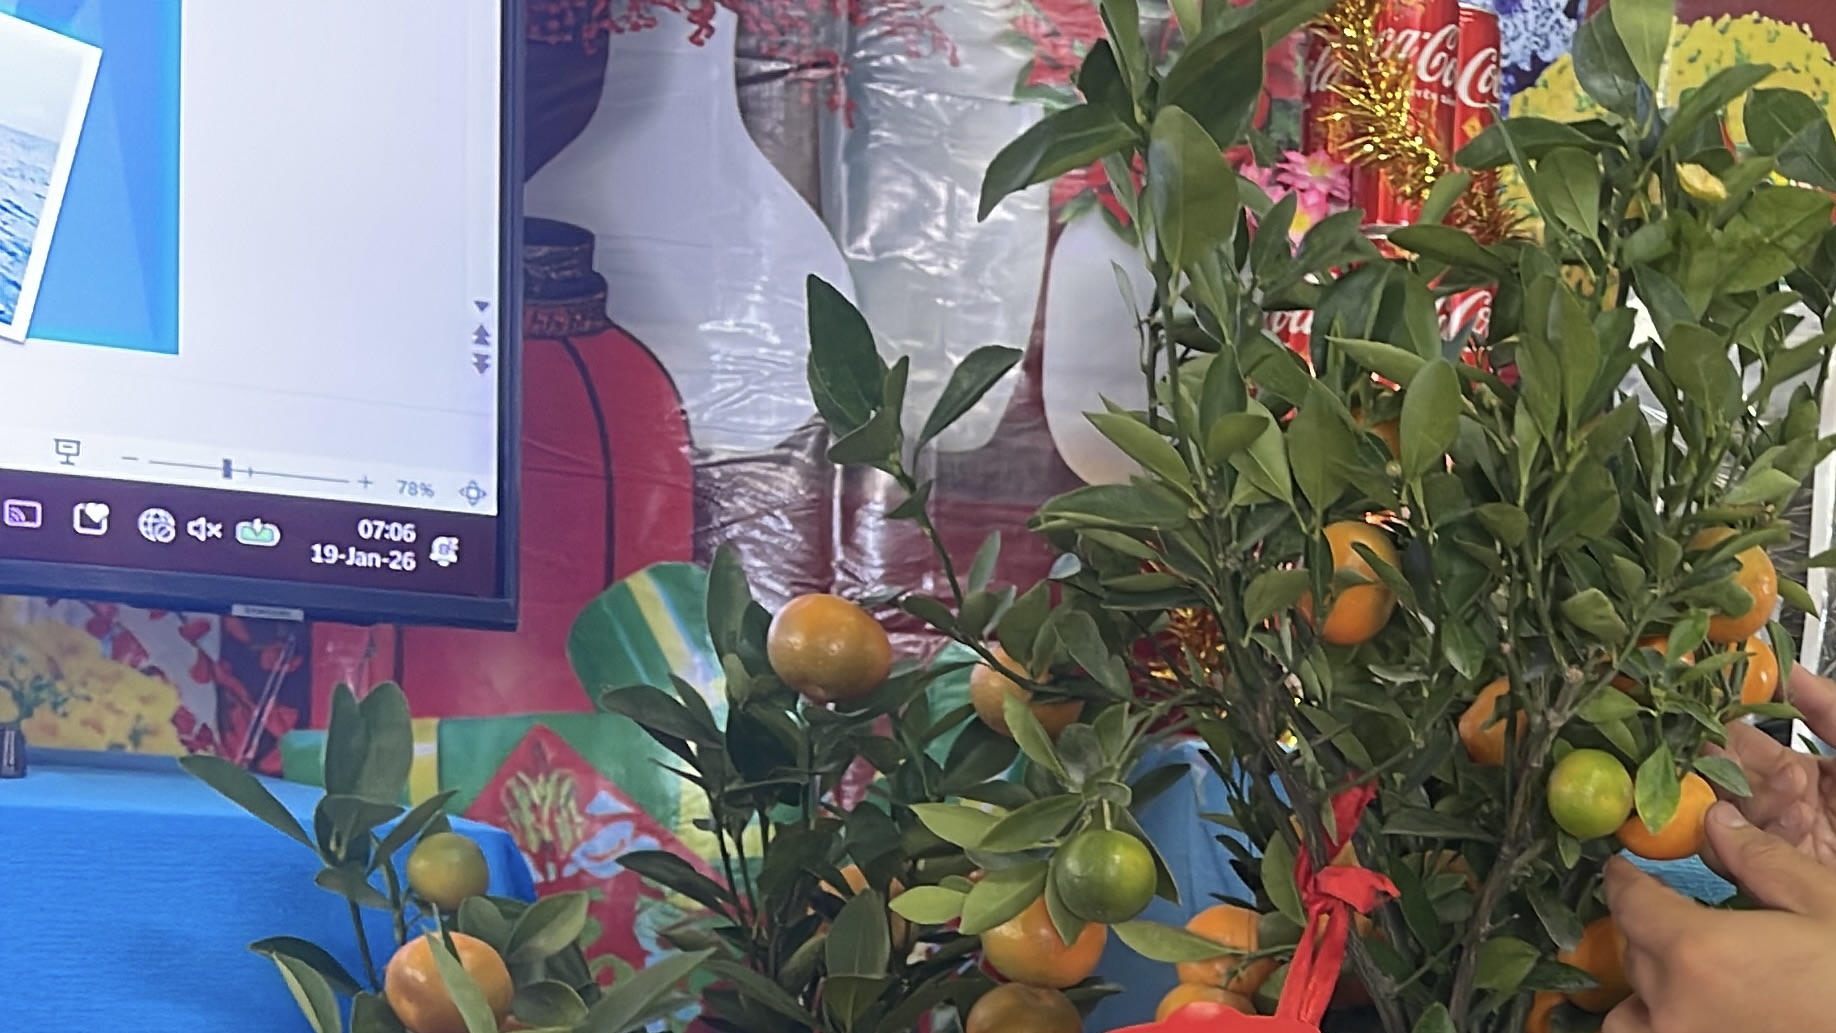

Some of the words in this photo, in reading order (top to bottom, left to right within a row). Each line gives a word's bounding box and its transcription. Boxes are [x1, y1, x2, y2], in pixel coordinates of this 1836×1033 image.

[397, 479, 435, 498] 78%
[358, 519, 416, 543] 07:06
[310, 543, 416, 571] 19-Jan-26
